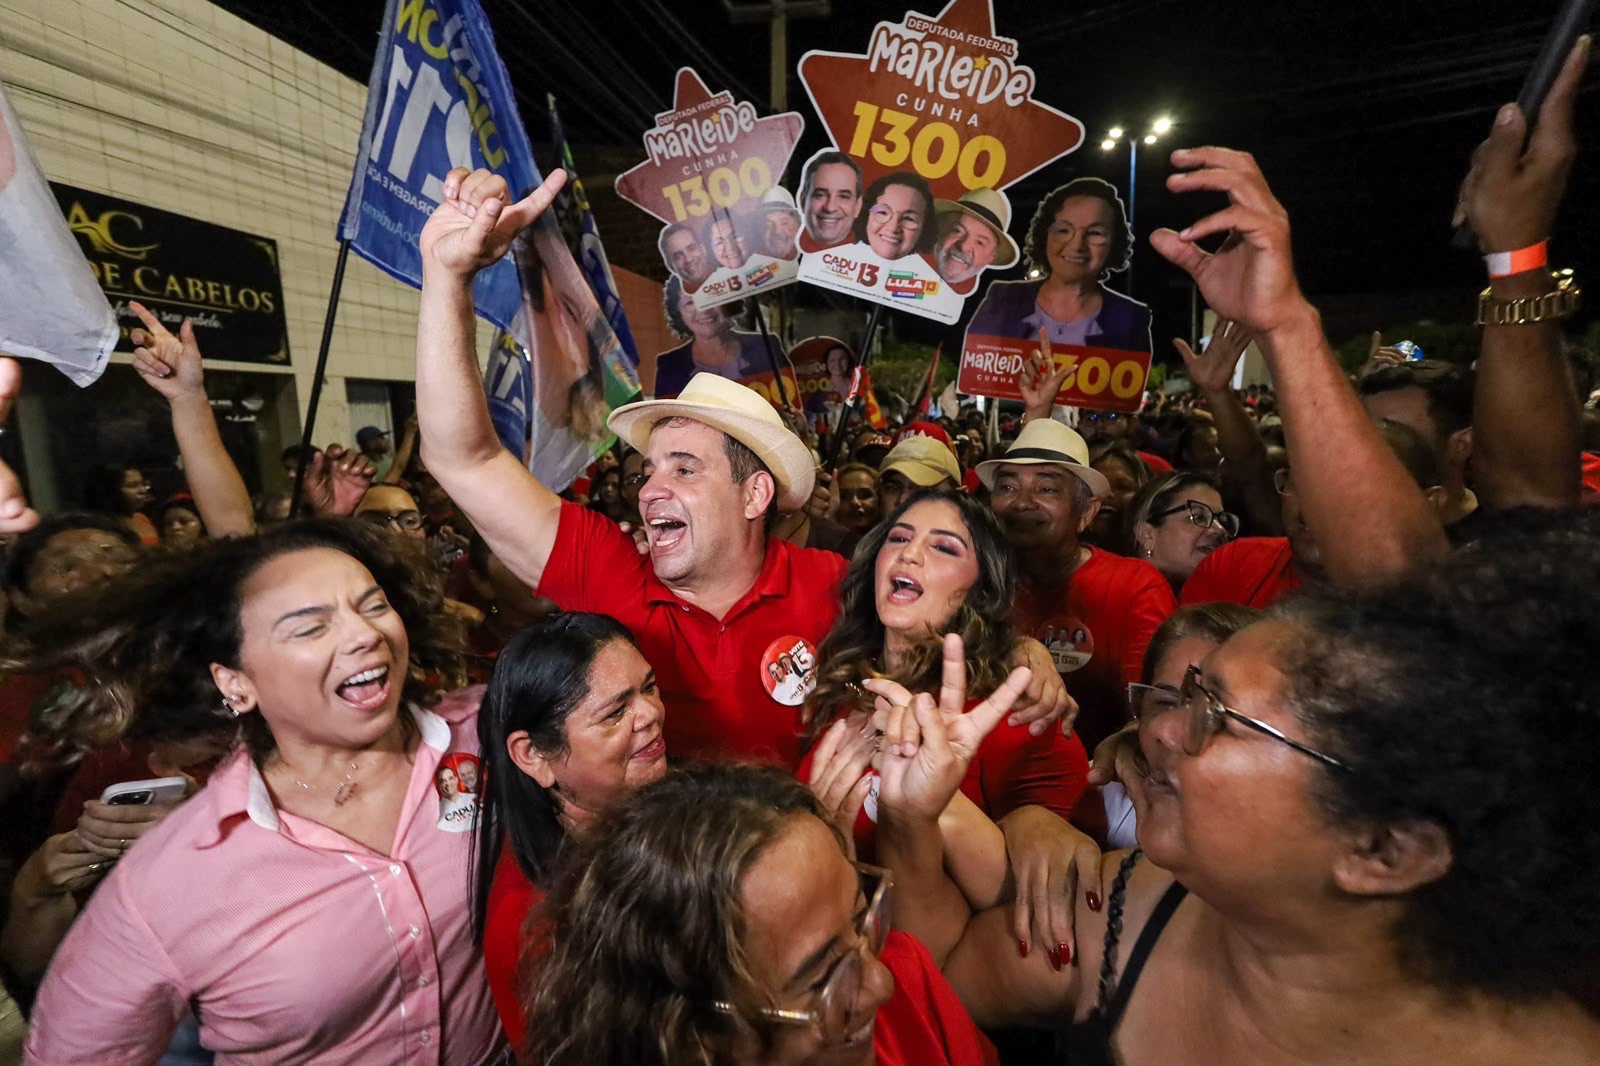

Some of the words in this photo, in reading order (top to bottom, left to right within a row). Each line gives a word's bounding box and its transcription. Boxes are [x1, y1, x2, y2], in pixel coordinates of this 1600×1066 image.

[907, 18, 964, 41] DEPUTADA
[966, 34, 1013, 55] FEDERAL
[659, 106, 698, 125] DEPUTADA
[697, 95, 730, 111] FEDERAL
[896, 93, 979, 127] CUNHA
[849, 100, 1007, 191] 1300
[682, 150, 738, 176] CUNHA
[662, 156, 771, 223] 1300
[727, 274, 742, 292] 13
[822, 253, 858, 271] CADU
[857, 262, 880, 287] 13
[886, 278, 923, 289] LULA
[926, 280, 938, 292] 13
[134, 266, 275, 313] CABELOS
[963, 351, 1025, 375] MaRLeiD
[976, 374, 1014, 384] CUNHA
[1052, 353, 1144, 399] 300
[444, 804, 474, 822] CADU
